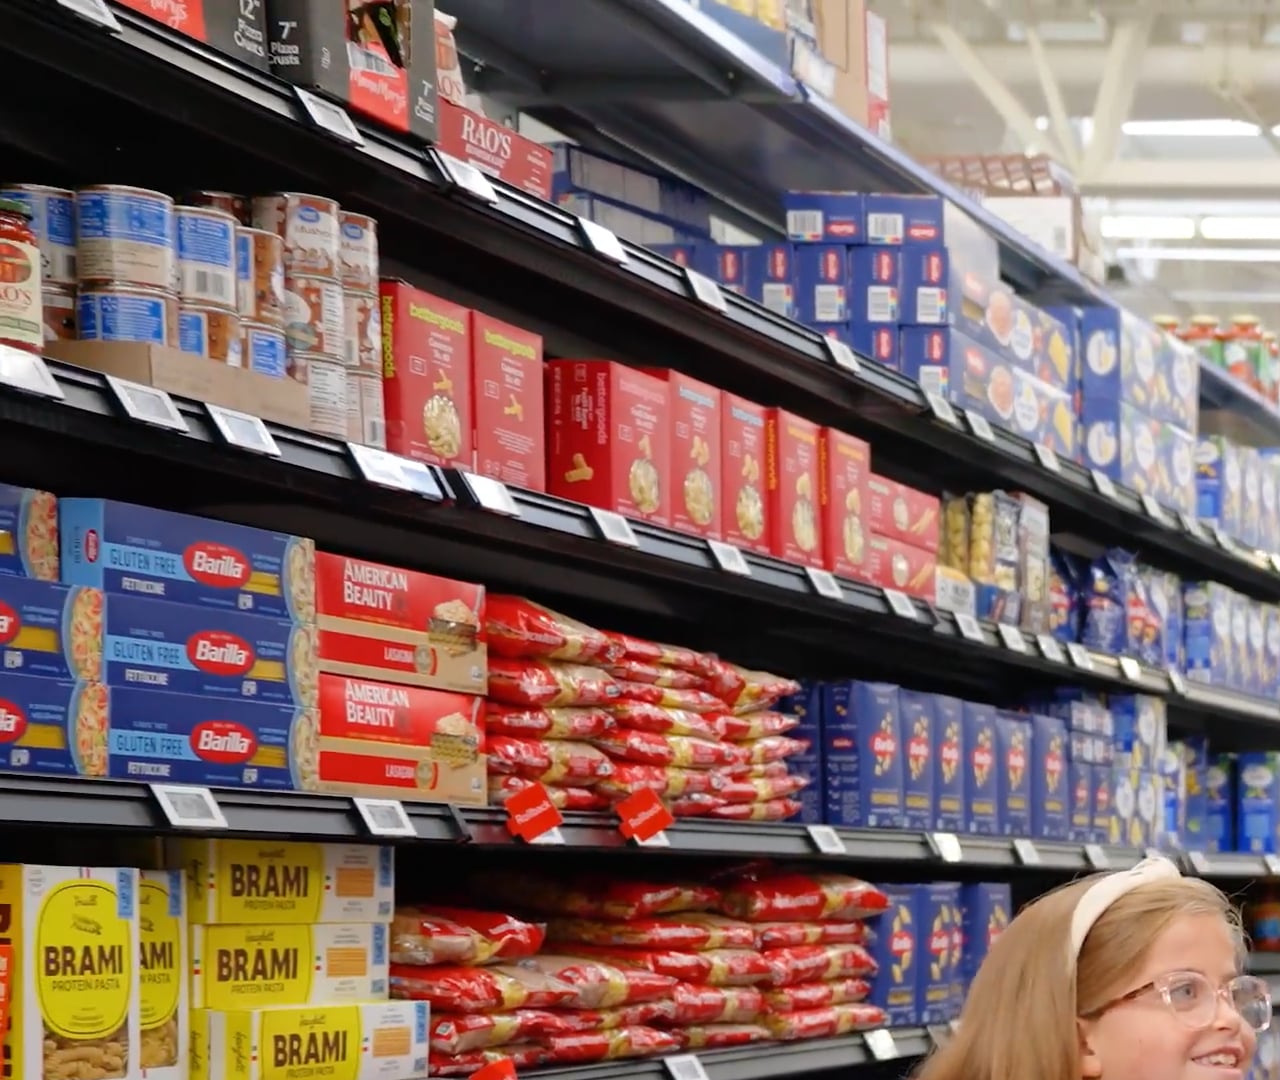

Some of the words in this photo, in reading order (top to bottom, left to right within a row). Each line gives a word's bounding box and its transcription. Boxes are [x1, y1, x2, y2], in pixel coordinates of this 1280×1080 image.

[462, 114, 512, 159] RAO'S
[109, 548, 151, 571] GLUTEN
[154, 554, 177, 576] FREE
[192, 550, 246, 579] Barilla
[344, 559, 408, 592] AMERICAN
[344, 581, 393, 611] BEAUTY
[113, 640, 155, 663] GLUTEN
[157, 645, 181, 666] FREE
[195, 641, 249, 666] Barilla
[345, 680, 410, 708] AMERICAN
[346, 701, 395, 727] BEAUTY
[116, 733, 158, 754] GLUTEN
[160, 736, 183, 757] FREE
[198, 731, 251, 754] Barilla
[230, 863, 309, 899] BRAMI
[243, 899, 277, 912] PROTEIN
[278, 898, 297, 911] PASTA
[44, 944, 123, 978] BRAMI
[217, 946, 298, 982] BRAMI
[52, 977, 93, 993] PROTEIN
[94, 976, 120, 991] PASTA
[147, 971, 172, 985] PASTA
[231, 981, 265, 995] PROTEIN
[265, 980, 286, 994] PASTA
[273, 1030, 347, 1068] BRAMI
[286, 1066, 316, 1080] PROTEIN
[315, 1063, 335, 1078] PASTA
